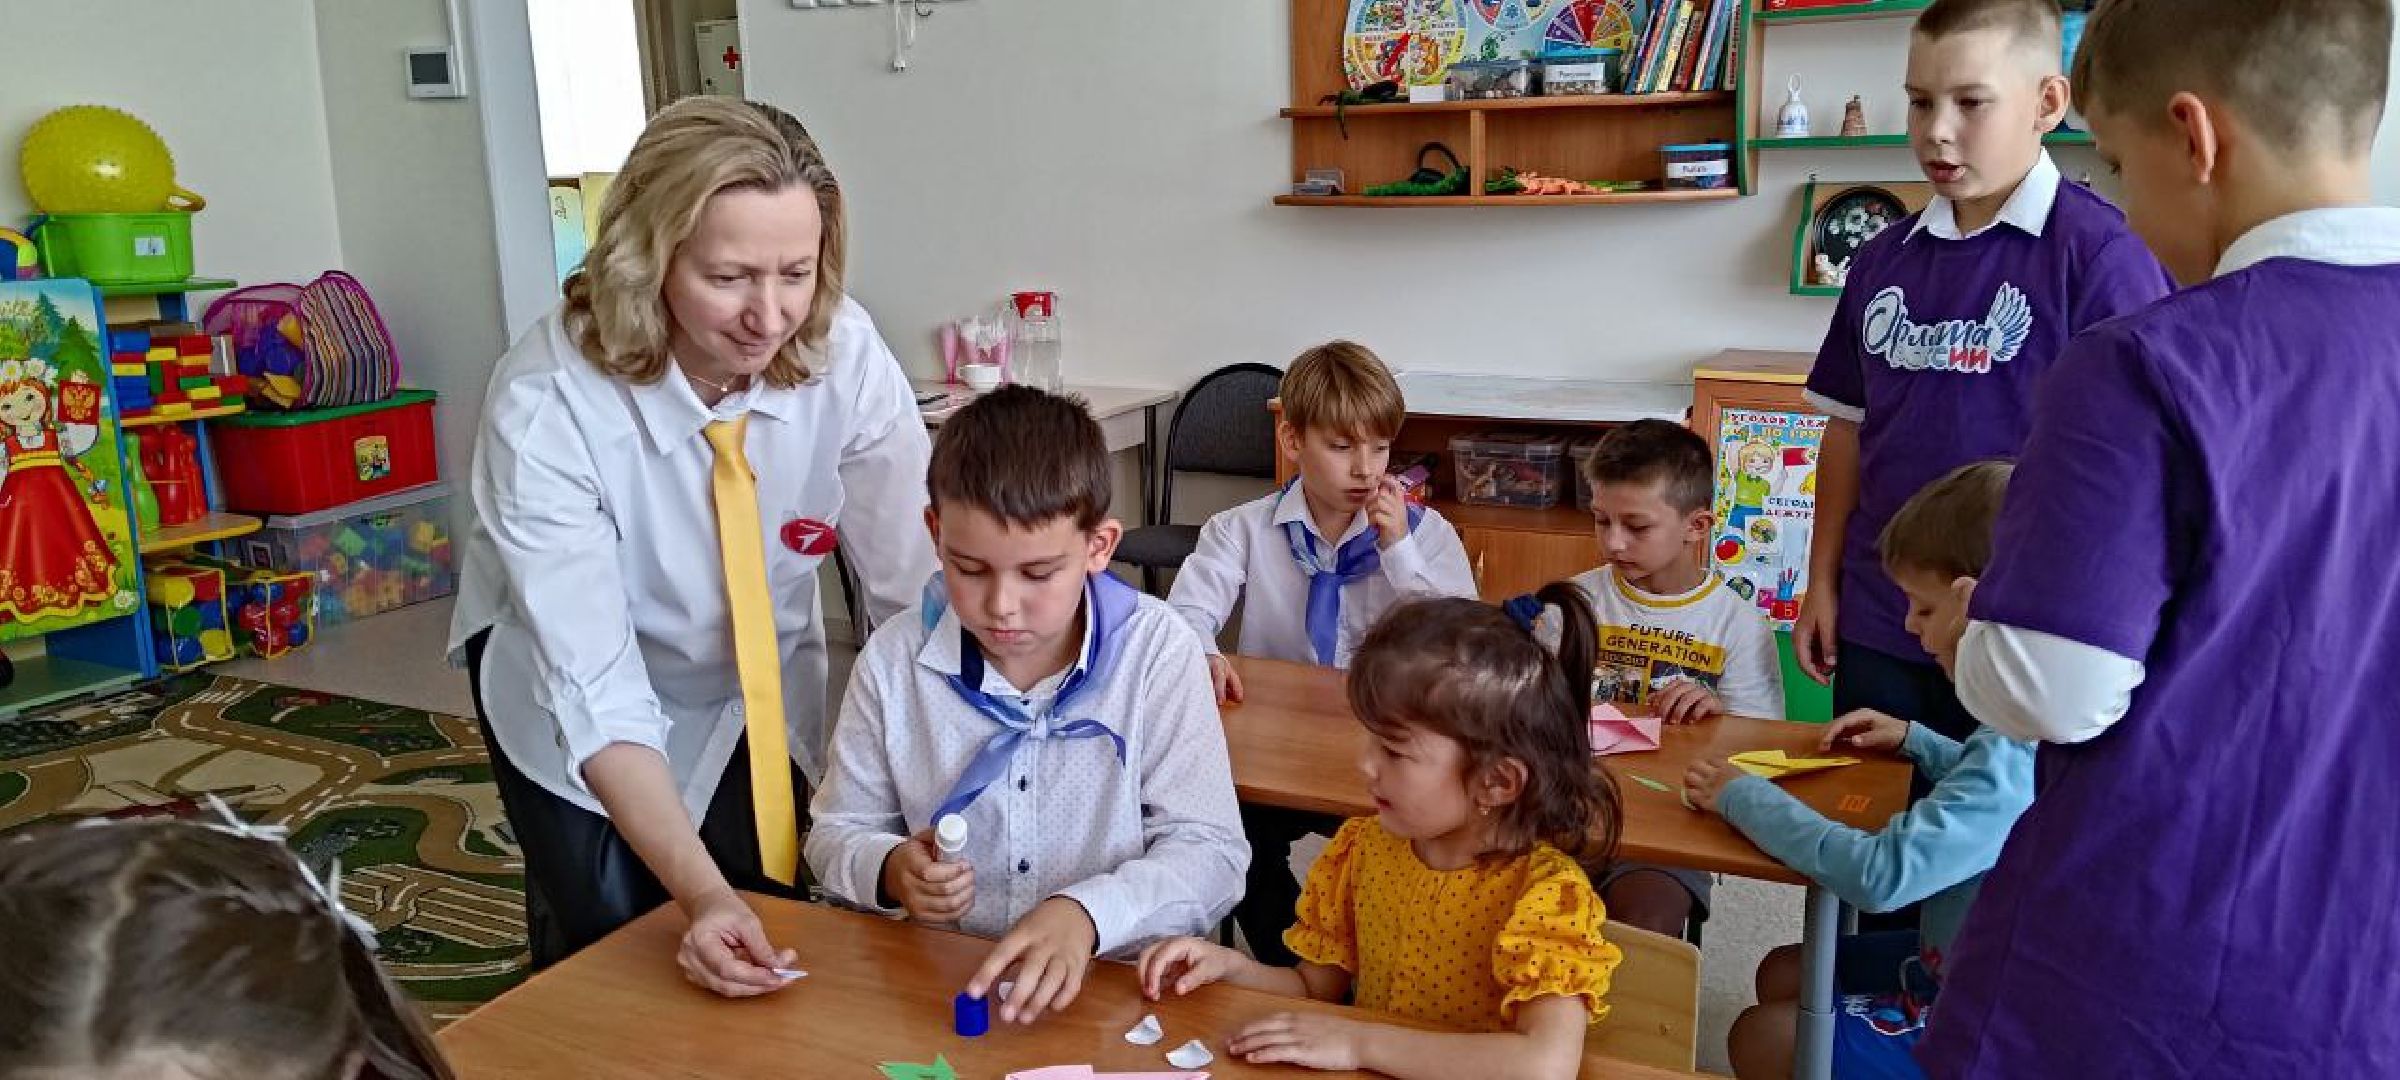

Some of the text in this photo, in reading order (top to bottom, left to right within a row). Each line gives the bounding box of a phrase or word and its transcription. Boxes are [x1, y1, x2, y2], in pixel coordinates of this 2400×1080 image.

[1729, 413, 1787, 426] УГОЛОК
[1629, 623, 1696, 646] FUTURE
[1605, 634, 1711, 666] GENERATION
